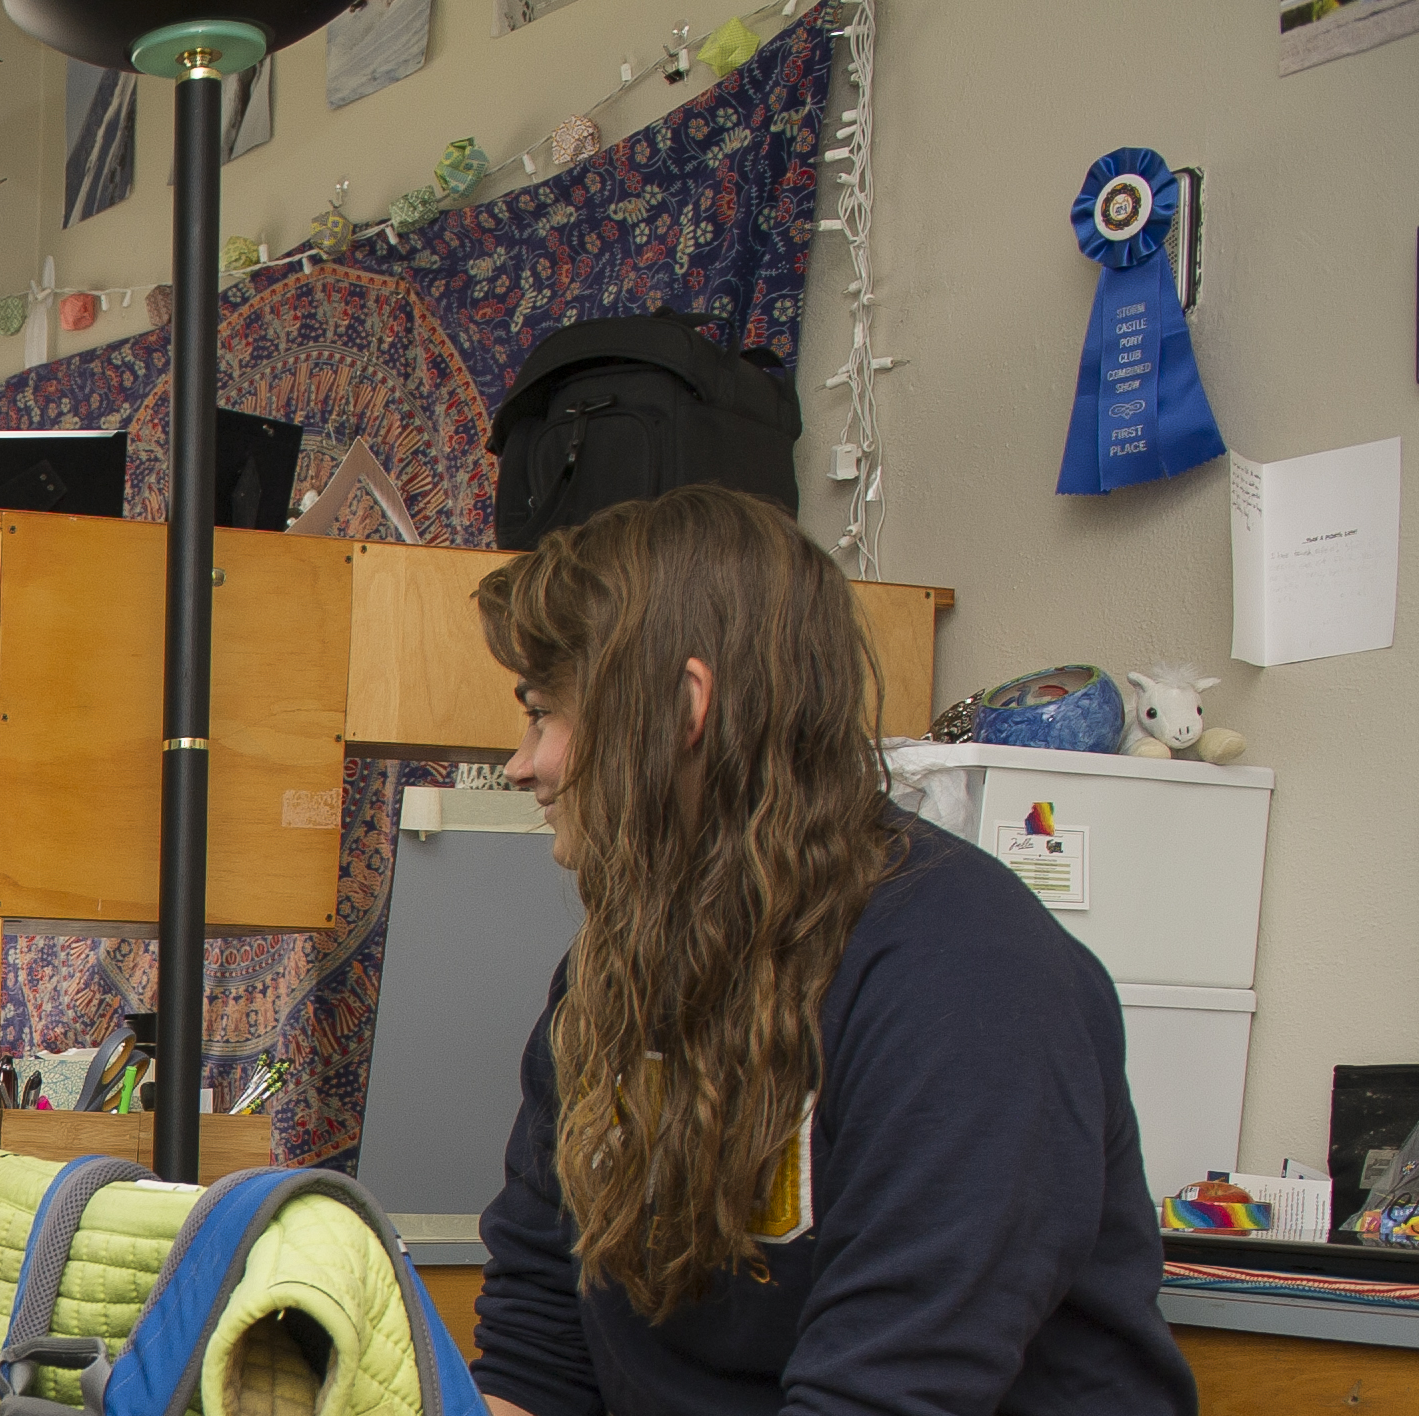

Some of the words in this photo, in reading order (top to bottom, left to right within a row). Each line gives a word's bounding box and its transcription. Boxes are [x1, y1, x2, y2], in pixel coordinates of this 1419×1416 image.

[1116, 302, 1146, 318] STORM
[1116, 317, 1147, 334] CASTLE
[1119, 334, 1144, 348] PONY
[1118, 349, 1142, 364] CLUB
[1107, 362, 1151, 381] COMBINED
[1115, 379, 1142, 394] SHOW
[1111, 425, 1144, 440] FIRST
[1109, 440, 1147, 457] PLACE
